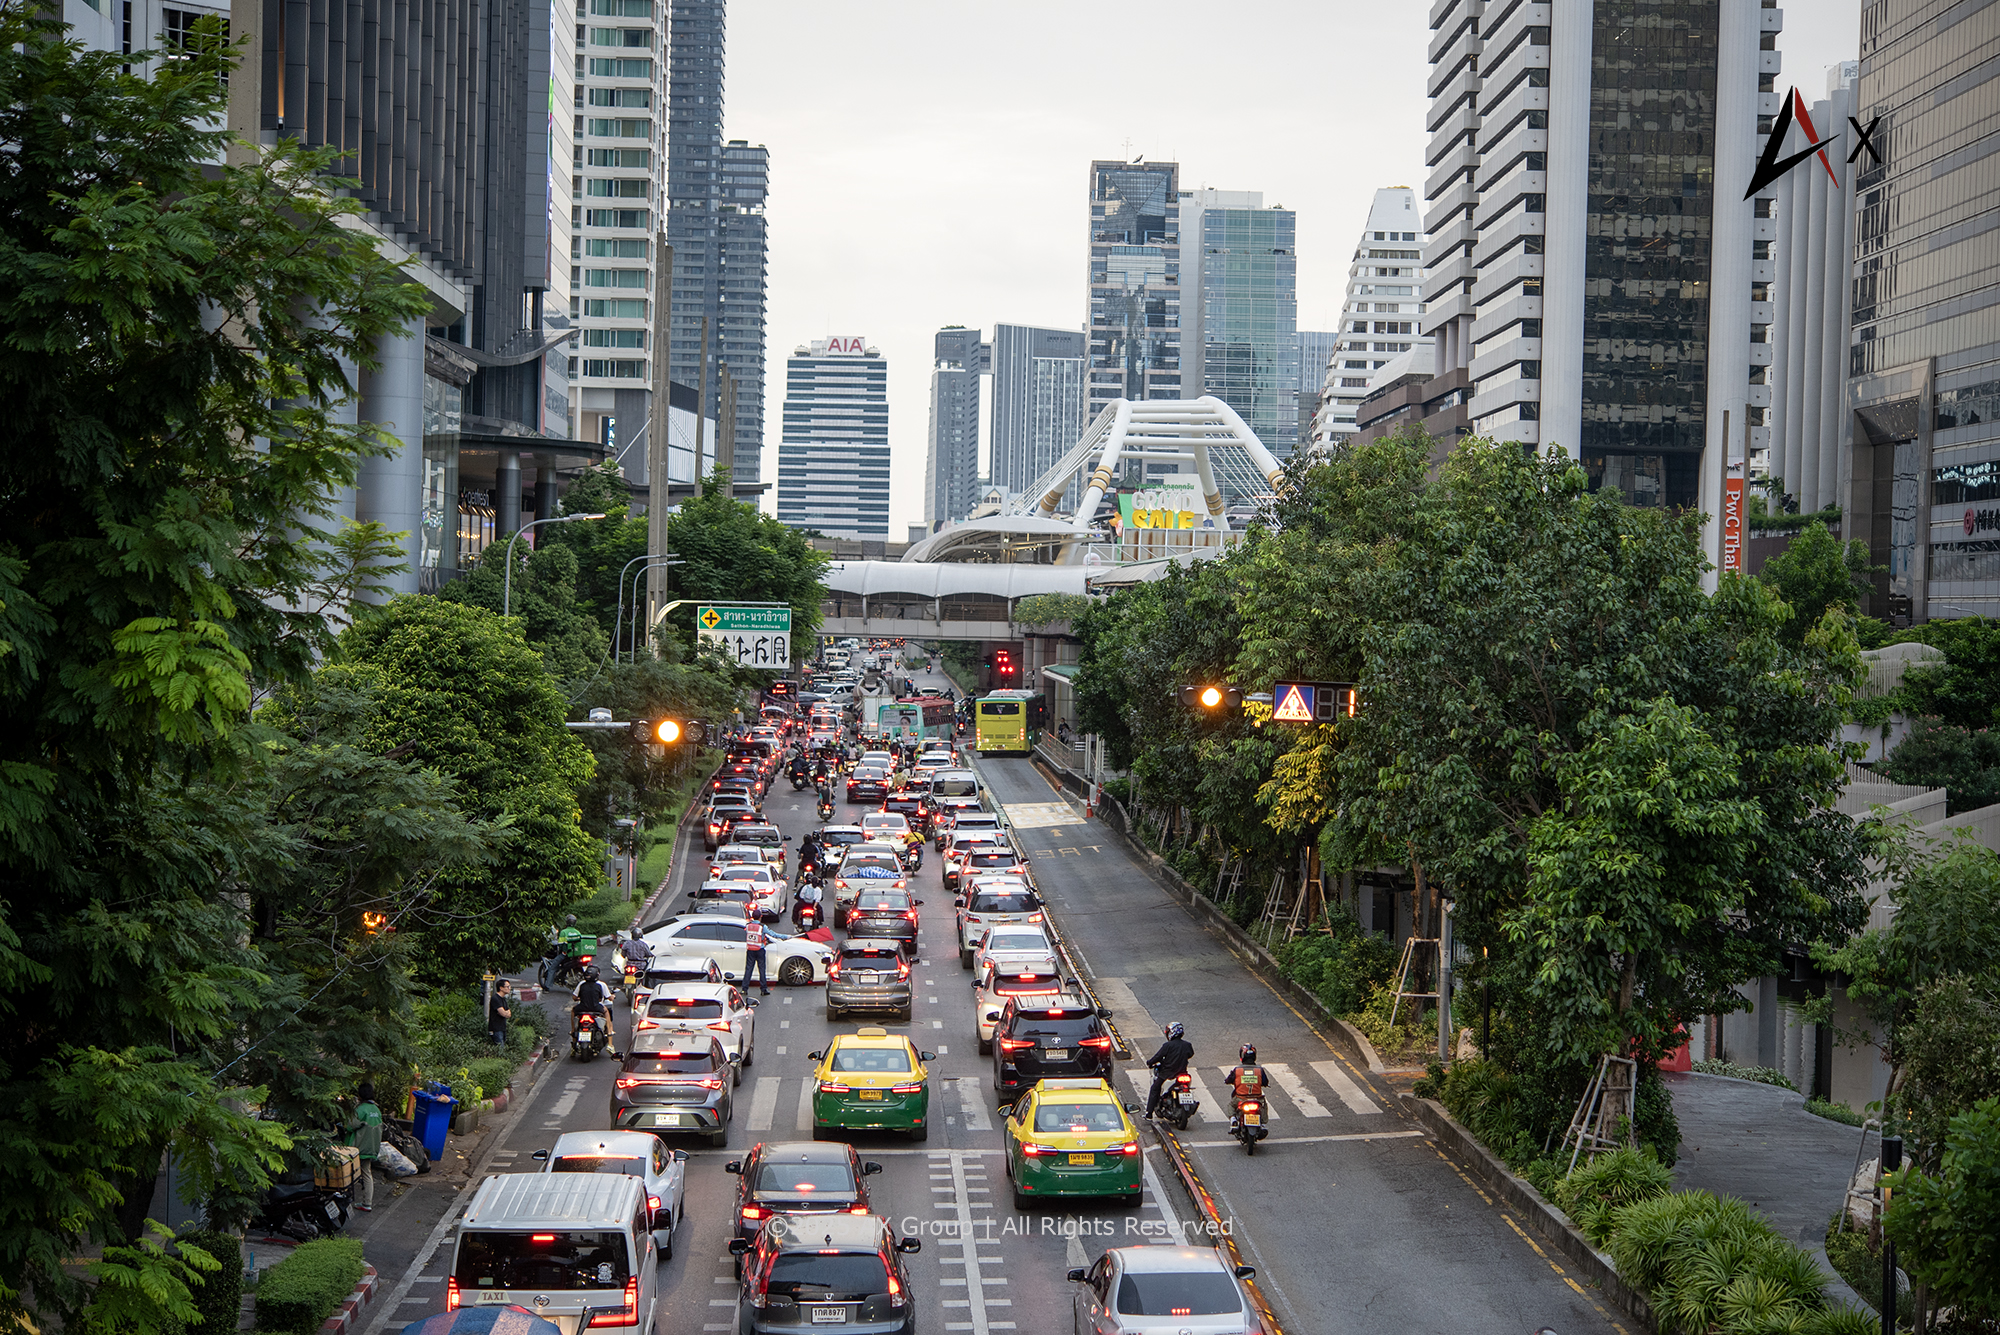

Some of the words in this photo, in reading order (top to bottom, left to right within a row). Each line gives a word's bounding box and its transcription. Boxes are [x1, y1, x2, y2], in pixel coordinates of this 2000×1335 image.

[828, 338, 863, 352] AIA
[1131, 491, 1194, 510] GRAND
[1725, 490, 1741, 528] PwC
[724, 610, 788, 622] สาทร-นราธิวาส
[482, 1292, 504, 1300] TAXI
